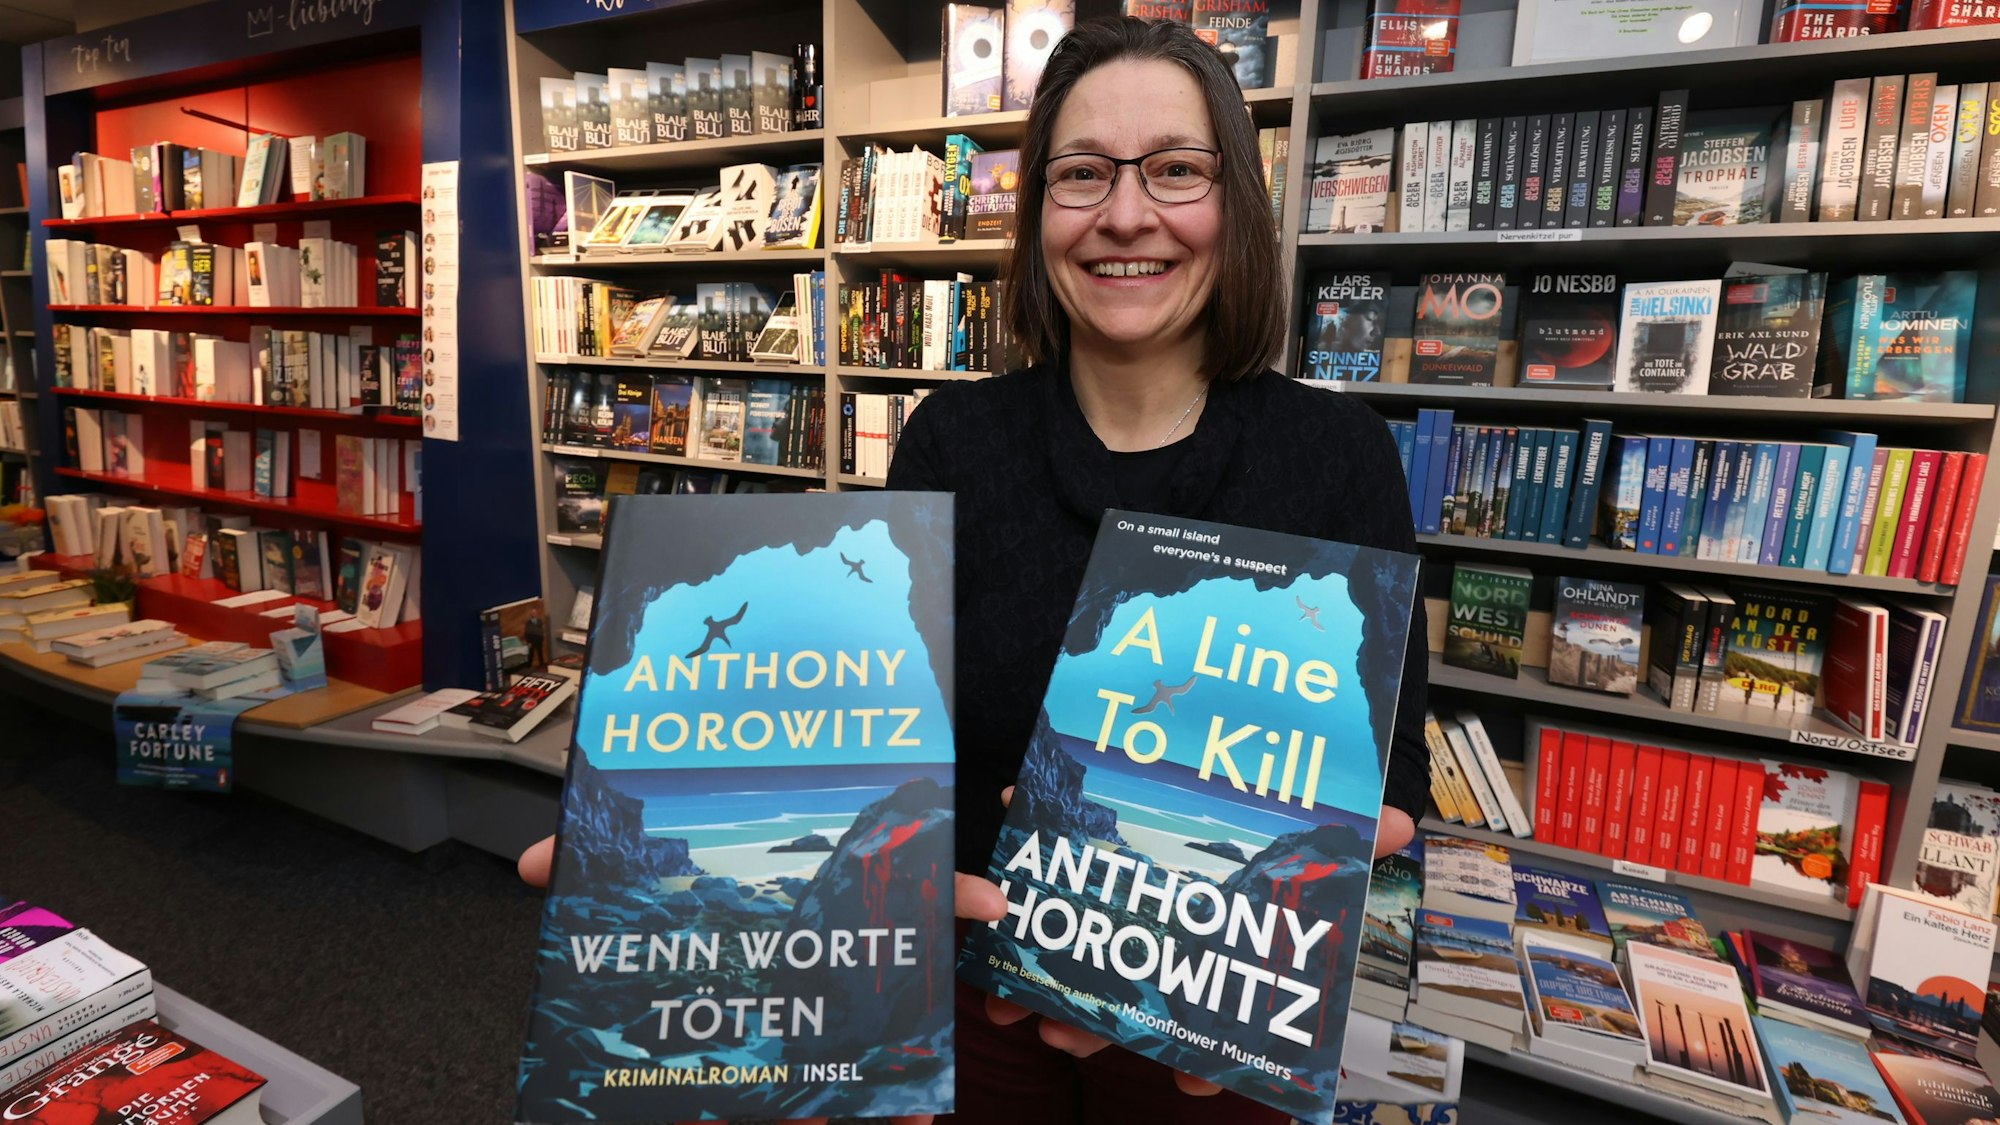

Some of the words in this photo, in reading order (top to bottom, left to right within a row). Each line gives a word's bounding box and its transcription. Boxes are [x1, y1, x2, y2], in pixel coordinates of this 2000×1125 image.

[1209, 15, 1251, 29] FEINDE
[1379, 19, 1417, 31] ELLIS
[1804, 13, 1834, 26] THE
[1375, 63, 1430, 76] SHARDS
[1376, 53, 1401, 65] THE
[1909, 78, 1931, 125] HYBRIS
[1930, 104, 1951, 144] OXEN
[1481, 132, 1493, 178] ERBARMEN
[1529, 129, 1542, 174] ERLÖSUNG
[1577, 125, 1591, 178] ERWARTUNG
[1602, 124, 1616, 184] VERHEISSUNG
[1630, 123, 1644, 163] SELFIES
[1703, 137, 1745, 149] STEFFEN
[1552, 127, 1566, 184] VERACHTUNG
[1679, 145, 1766, 168] JACOBSEN
[1837, 136, 1858, 190] JACOBSEN
[1873, 134, 1896, 189] JACOBSEN
[1906, 131, 1929, 187] JACOBSEN
[1313, 174, 1389, 199] VERSCHWIEGEN
[1684, 166, 1760, 184] TROPHAE
[1794, 171, 1811, 211] JACOBSEN
[1500, 232, 1555, 241] Nervenkitzel
[1558, 233, 1573, 241] pur
[1333, 275, 1371, 287] LARS
[1424, 273, 1505, 285] JOHANNA
[1532, 275, 1551, 294] JO
[1556, 273, 1616, 294] NESBØ
[1318, 286, 1384, 301] KEPLER
[1417, 282, 1502, 320] MO
[1641, 295, 1713, 317] HELSINKI
[1890, 310, 1938, 320] ARTTU
[1539, 326, 1604, 336] blutmond
[1718, 331, 1745, 340] ERIK
[1749, 330, 1772, 339] AXL
[1775, 330, 1810, 338] SUND
[1308, 350, 1380, 367] SPINNEN
[1655, 358, 1673, 368] TOTE
[1727, 341, 1802, 361] WALD
[1422, 362, 1483, 373] DUNKELWALD
[1639, 367, 1686, 377] CONTAINER
[1722, 362, 1797, 381] GRAB
[1582, 431, 1604, 485] FLAMMENMEER
[1676, 467, 1691, 497] PROVENCE
[1773, 487, 1787, 518] RETOUR
[1117, 520, 1134, 532] On
[1137, 523, 1145, 533] a
[1147, 523, 1180, 539] small
[1182, 527, 1221, 545] island
[1152, 543, 1221, 565] everyone's
[1223, 554, 1231, 566] a
[1234, 556, 1288, 576] suspect
[1457, 571, 1484, 582] SVEA
[1490, 576, 1530, 588] JENSEN
[1589, 582, 1614, 593] NINA
[1456, 581, 1528, 607] NORD
[1562, 586, 1640, 606] OHLANDT
[1452, 602, 1521, 630] WEST
[1745, 602, 1809, 623] MORD
[1449, 624, 1523, 649] SCHULD
[1731, 617, 1757, 632] AN
[1775, 622, 1818, 641] DER
[1110, 605, 1164, 666] A
[1193, 615, 1339, 704] Line
[1736, 633, 1807, 657] KÜSTE
[623, 649, 907, 692] ANTHONY
[517, 676, 562, 692] FIFTY
[134, 722, 206, 742] CARLEY
[602, 708, 921, 753] HOROWITZ
[129, 740, 215, 761] FORTUNE
[1095, 688, 1167, 765] To
[1198, 715, 1327, 812] Kill
[1796, 731, 1907, 759] Nord/Ostsee
[1928, 831, 1992, 854] SCHWAB
[1622, 865, 1650, 876] Kanada
[1513, 872, 1590, 896] SCHWARZE
[1535, 883, 1571, 899] TAGE
[1004, 829, 1333, 972] ANTHONY
[1610, 891, 1686, 911] ABSCHIED
[1903, 911, 1921, 924] Ein
[1923, 915, 1959, 935] kaltes
[1961, 928, 1991, 944] Herz
[1928, 909, 1961, 925] Fabio
[1963, 919, 1992, 936] Lanz
[570, 932, 720, 974] WENN
[739, 927, 917, 970] WORTE
[987, 879, 1322, 1048] HOROWITZ
[58, 1003, 94, 1025] KASTEL
[58, 1004, 107, 1031] MICHAELA
[650, 985, 824, 1041] TÖTEN
[988, 954, 1001, 967] By
[1002, 957, 1019, 975] the
[1019, 961, 1072, 997] bestselling
[1072, 985, 1108, 1010] author
[1108, 1000, 1122, 1014] of
[1122, 1002, 1219, 1052] Moonflower
[1220, 1040, 1293, 1081] Murders
[62, 1029, 98, 1050] KASTEL
[2, 1032, 159, 1120] Grangé
[603, 1064, 789, 1088] KRIMINALROMAN
[802, 1062, 864, 1083] INSEL
[117, 1092, 155, 1116] DIE
